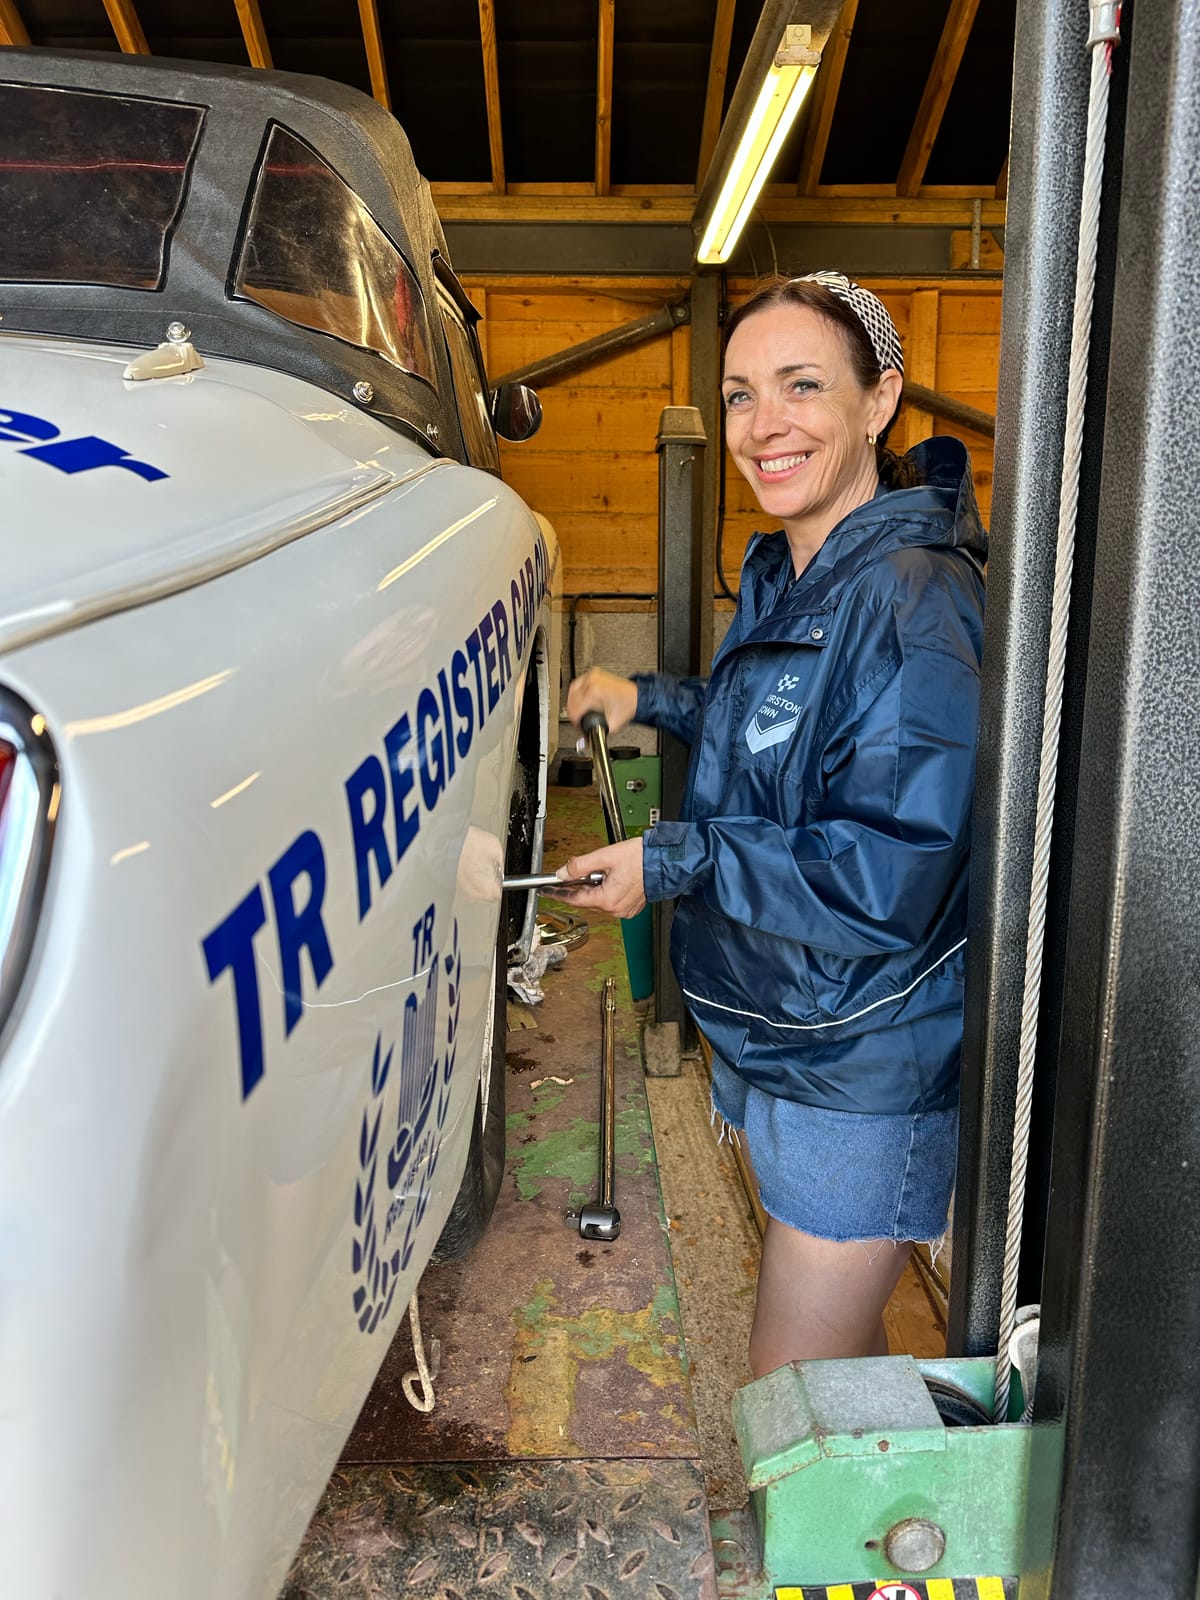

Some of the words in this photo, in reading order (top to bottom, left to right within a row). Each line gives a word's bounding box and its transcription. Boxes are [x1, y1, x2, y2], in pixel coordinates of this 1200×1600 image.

[758, 705, 779, 718] OWN
[201, 829, 334, 1104] TR
[344, 599, 512, 925] REGISTER
[511, 556, 535, 661] CAR
[413, 902, 435, 978] TR
